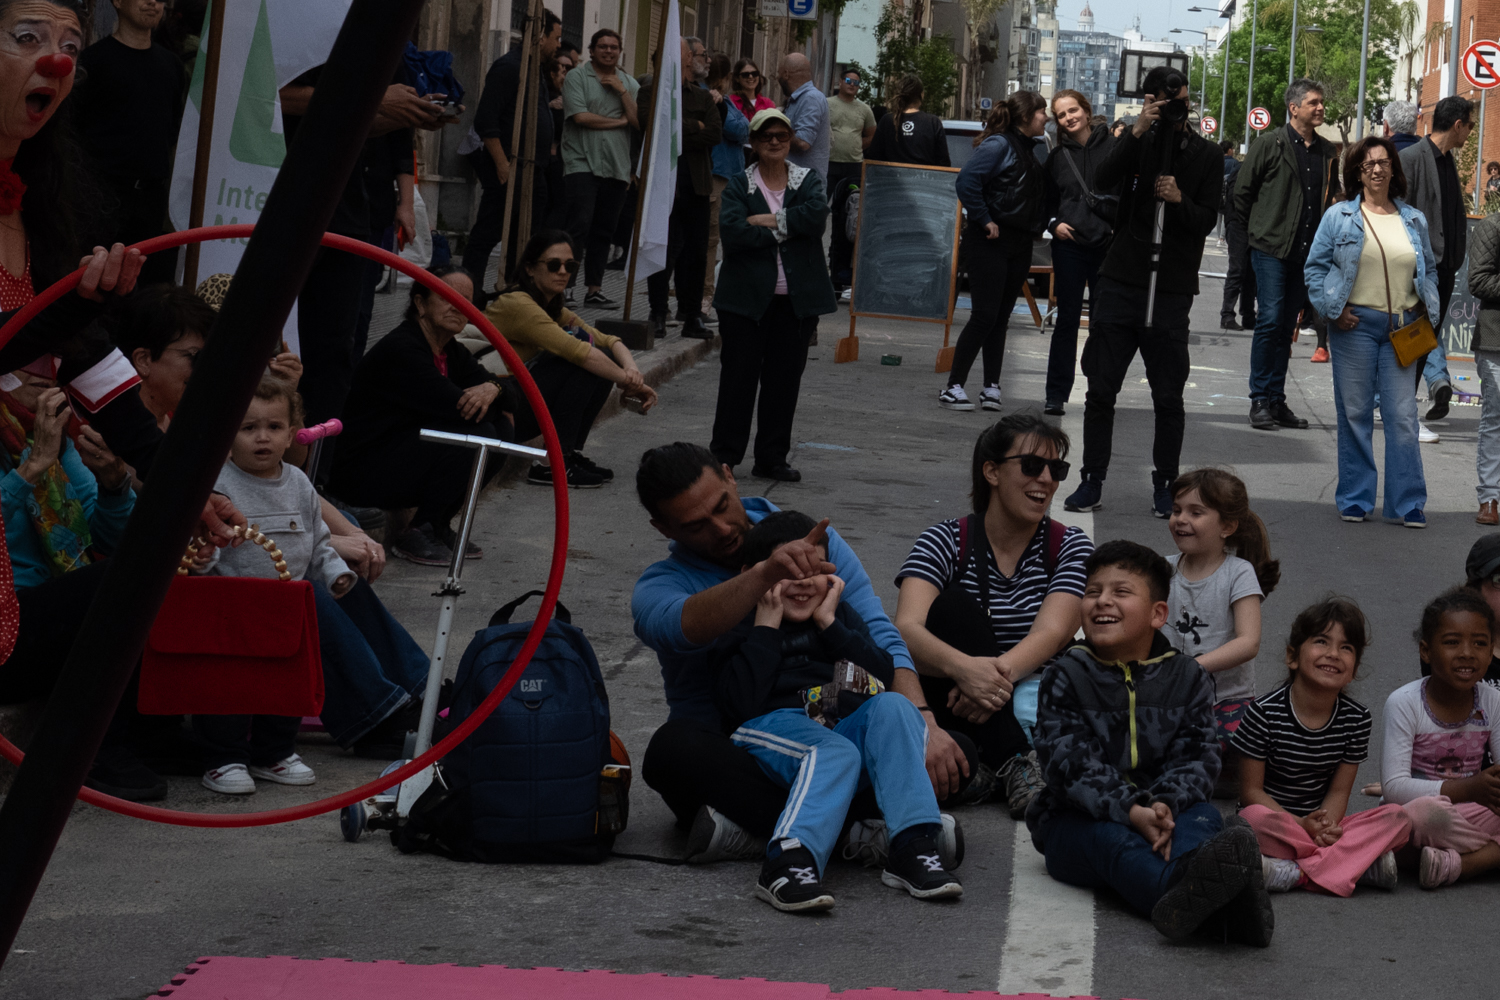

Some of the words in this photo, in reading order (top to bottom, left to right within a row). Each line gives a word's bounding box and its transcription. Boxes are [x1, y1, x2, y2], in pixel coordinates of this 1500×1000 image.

[1475, 50, 1496, 79] E
[1254, 112, 1264, 125] E
[520, 679, 543, 693] CAT
